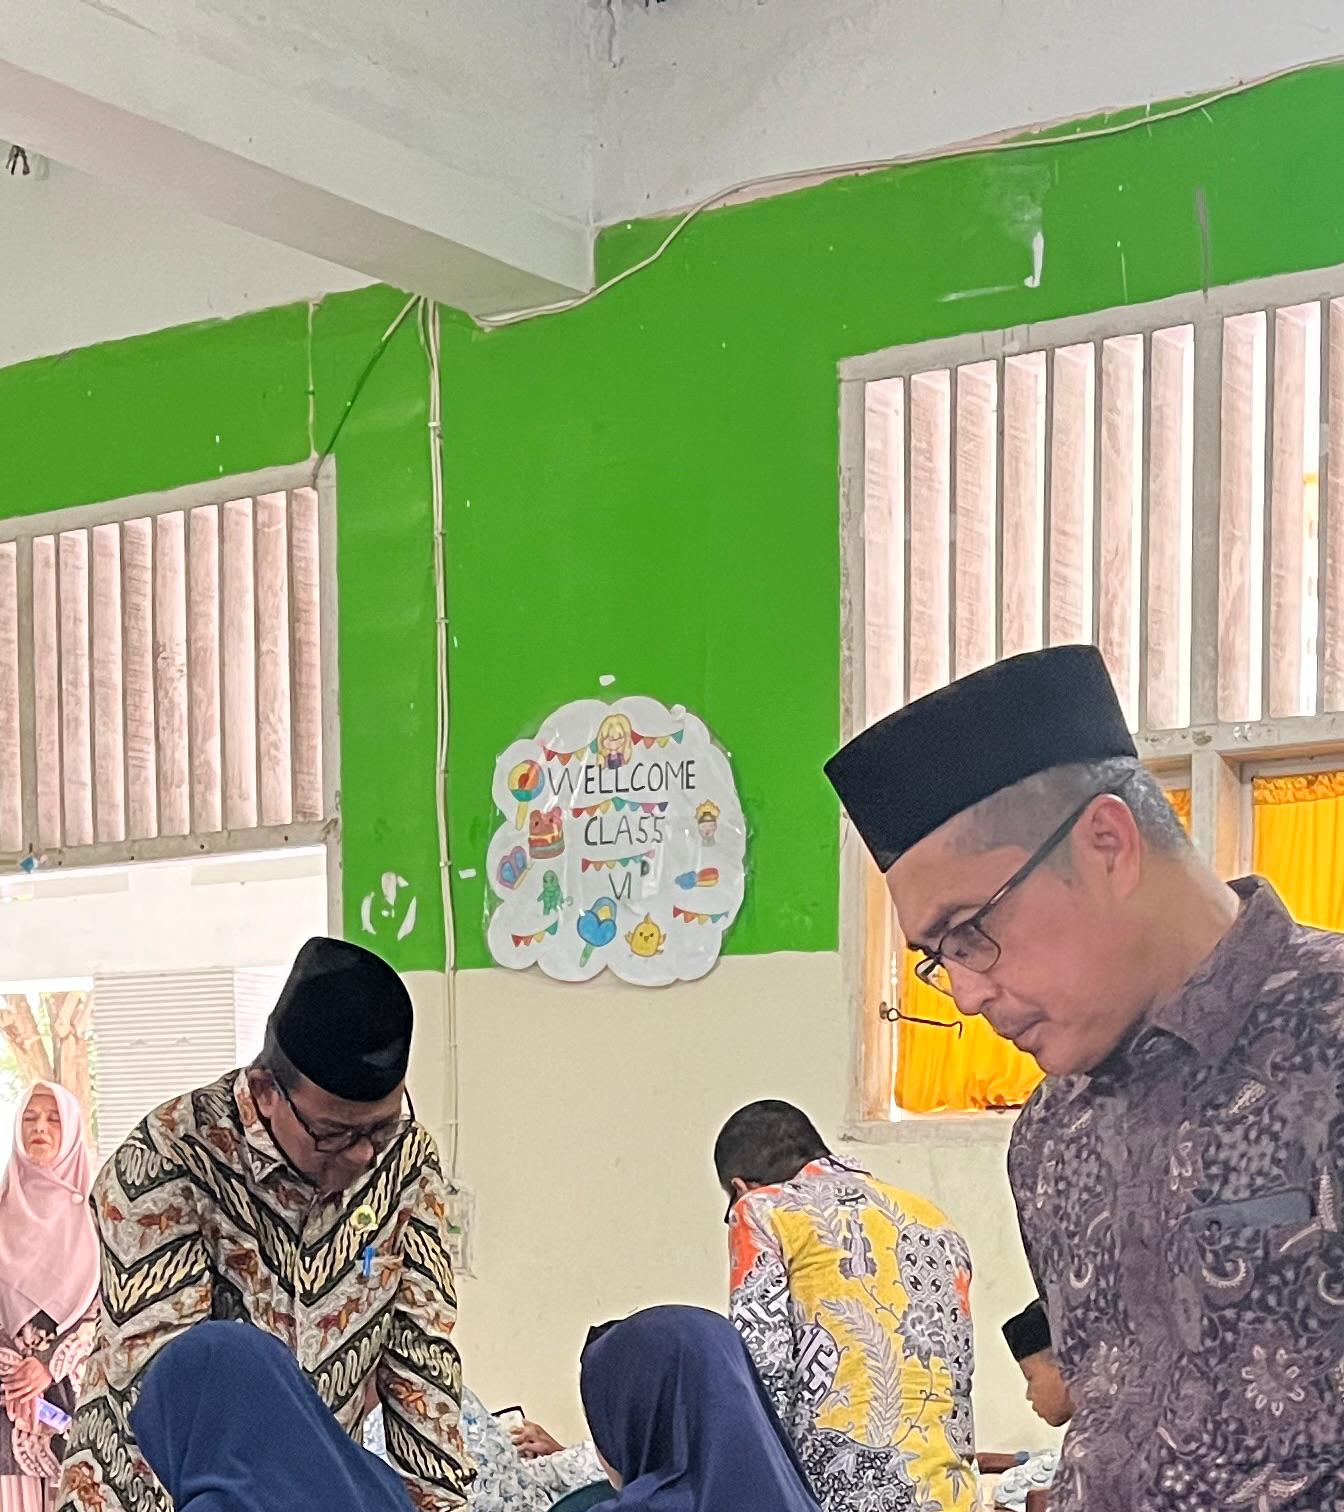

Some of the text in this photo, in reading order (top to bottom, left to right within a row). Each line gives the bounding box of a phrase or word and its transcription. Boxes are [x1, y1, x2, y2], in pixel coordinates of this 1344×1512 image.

[547, 760, 696, 796] WELLCOME
[584, 814, 666, 846] CLASS
[608, 871, 632, 900] VI
